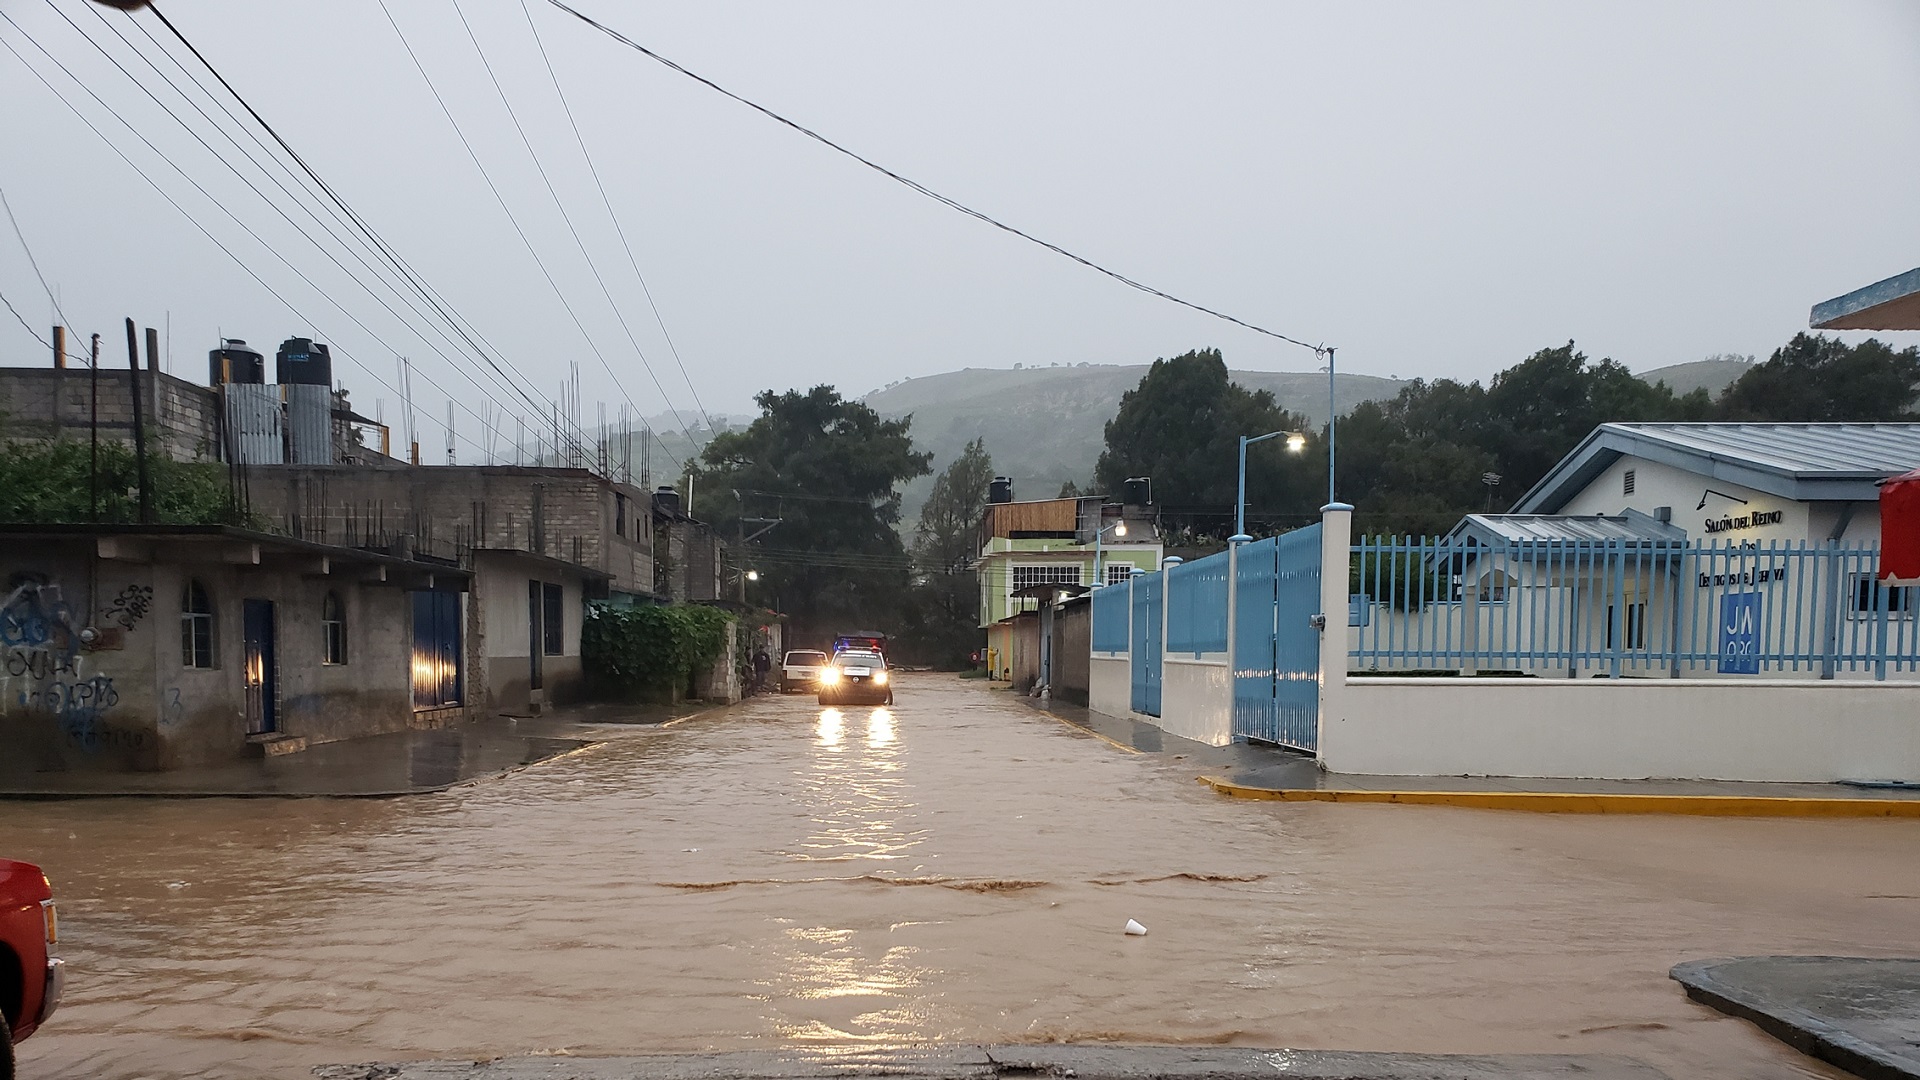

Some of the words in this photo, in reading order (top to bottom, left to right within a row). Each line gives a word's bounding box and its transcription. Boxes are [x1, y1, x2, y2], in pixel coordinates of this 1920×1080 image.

[1734, 516, 1749, 529] DEL
[1751, 510, 1782, 526] REINO
[1749, 564, 1784, 586] JEHVÁ
